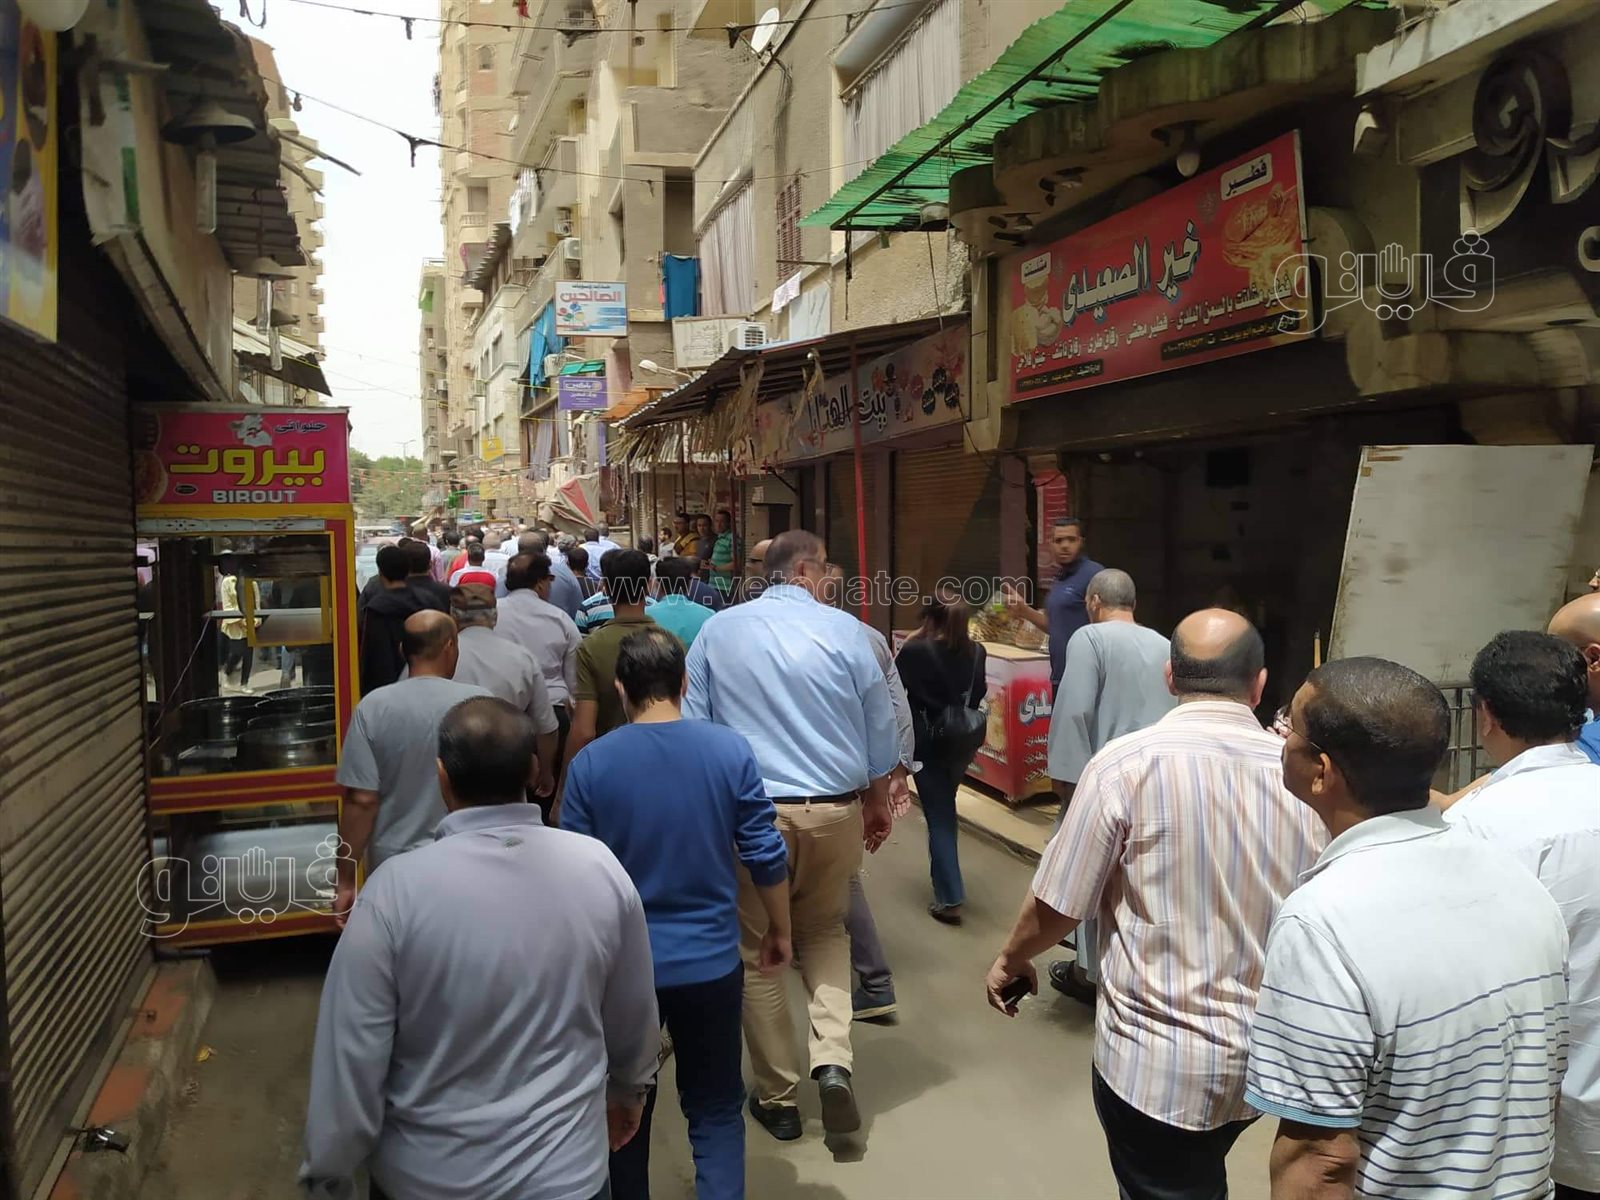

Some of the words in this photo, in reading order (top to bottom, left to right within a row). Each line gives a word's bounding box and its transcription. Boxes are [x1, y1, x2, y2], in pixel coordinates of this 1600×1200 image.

[1225, 159, 1267, 197] فطير
[169, 445, 325, 487] بيروت
[212, 490, 298, 504] BIROUT
